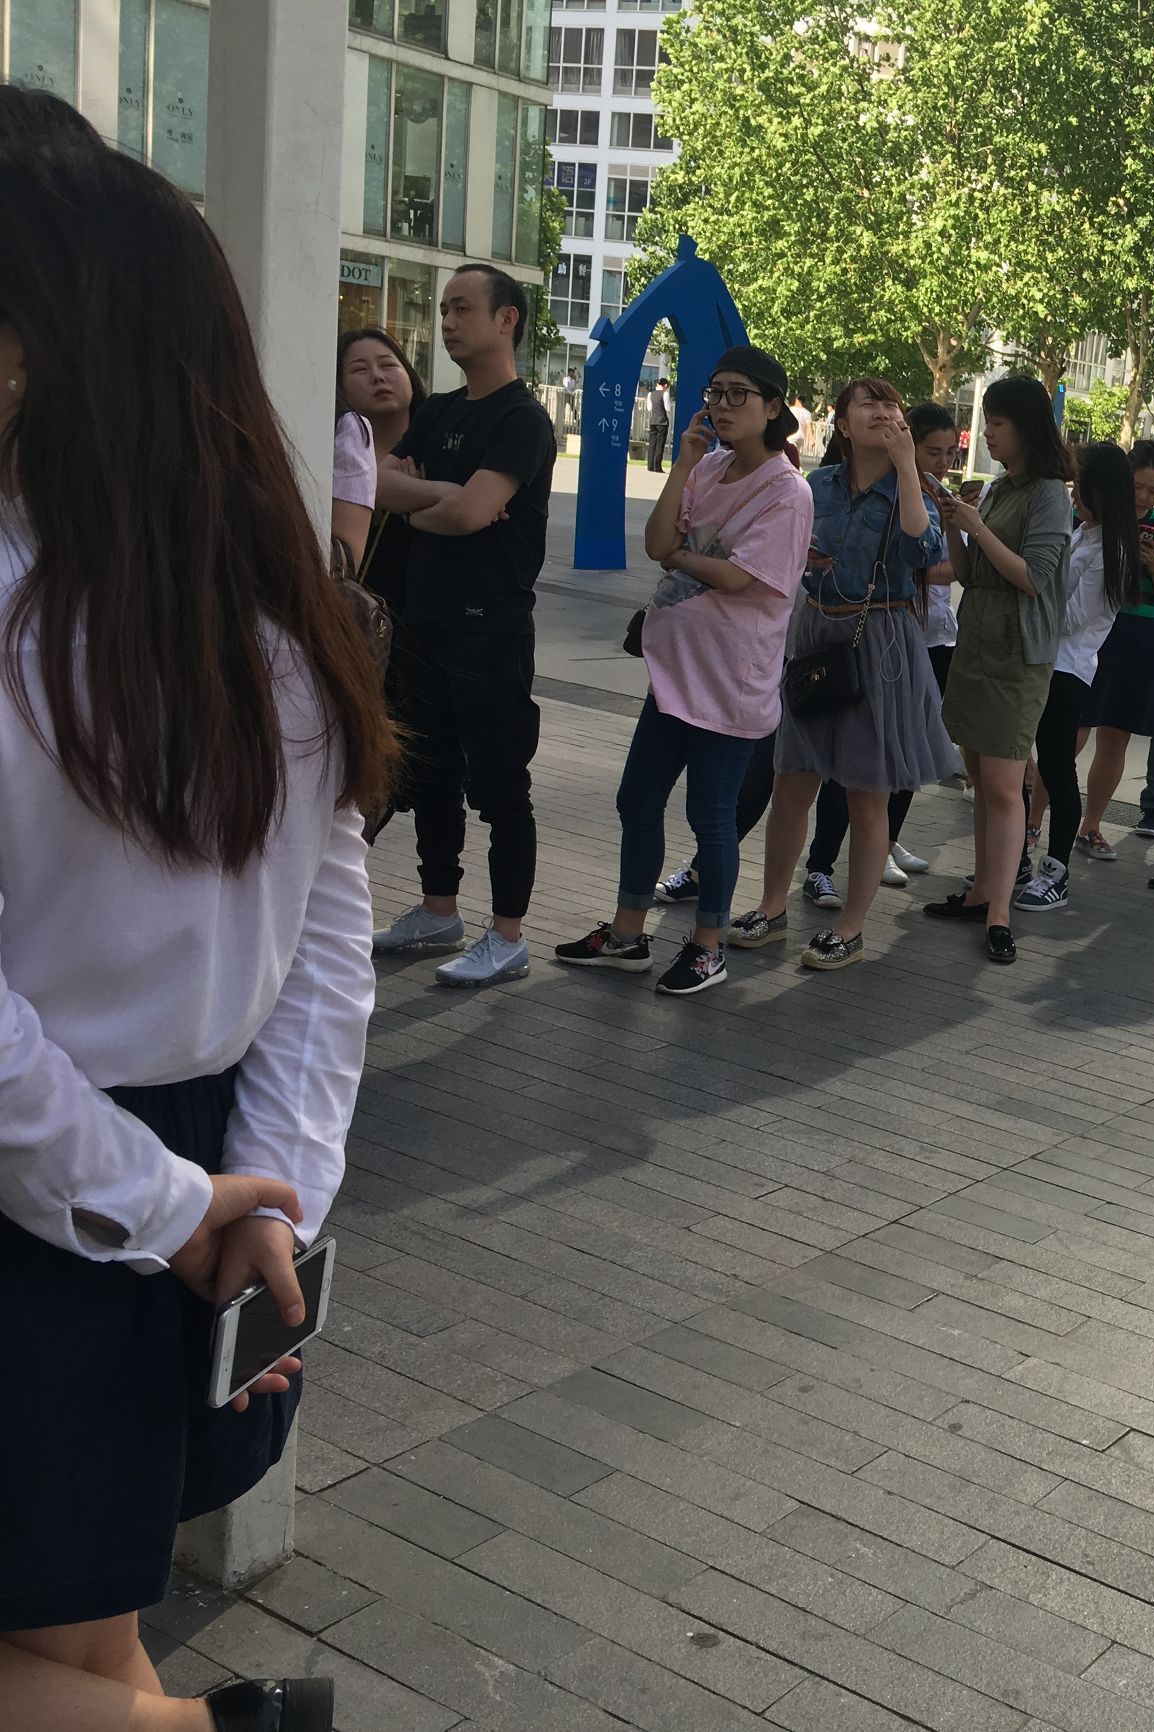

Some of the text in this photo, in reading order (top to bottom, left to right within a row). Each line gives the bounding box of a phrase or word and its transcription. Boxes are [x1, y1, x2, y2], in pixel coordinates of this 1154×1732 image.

[166, 103, 194, 118] ONLY
[341, 264, 371, 282] DOT
[614, 383, 621, 397] 8
[611, 418, 618, 431] 9
